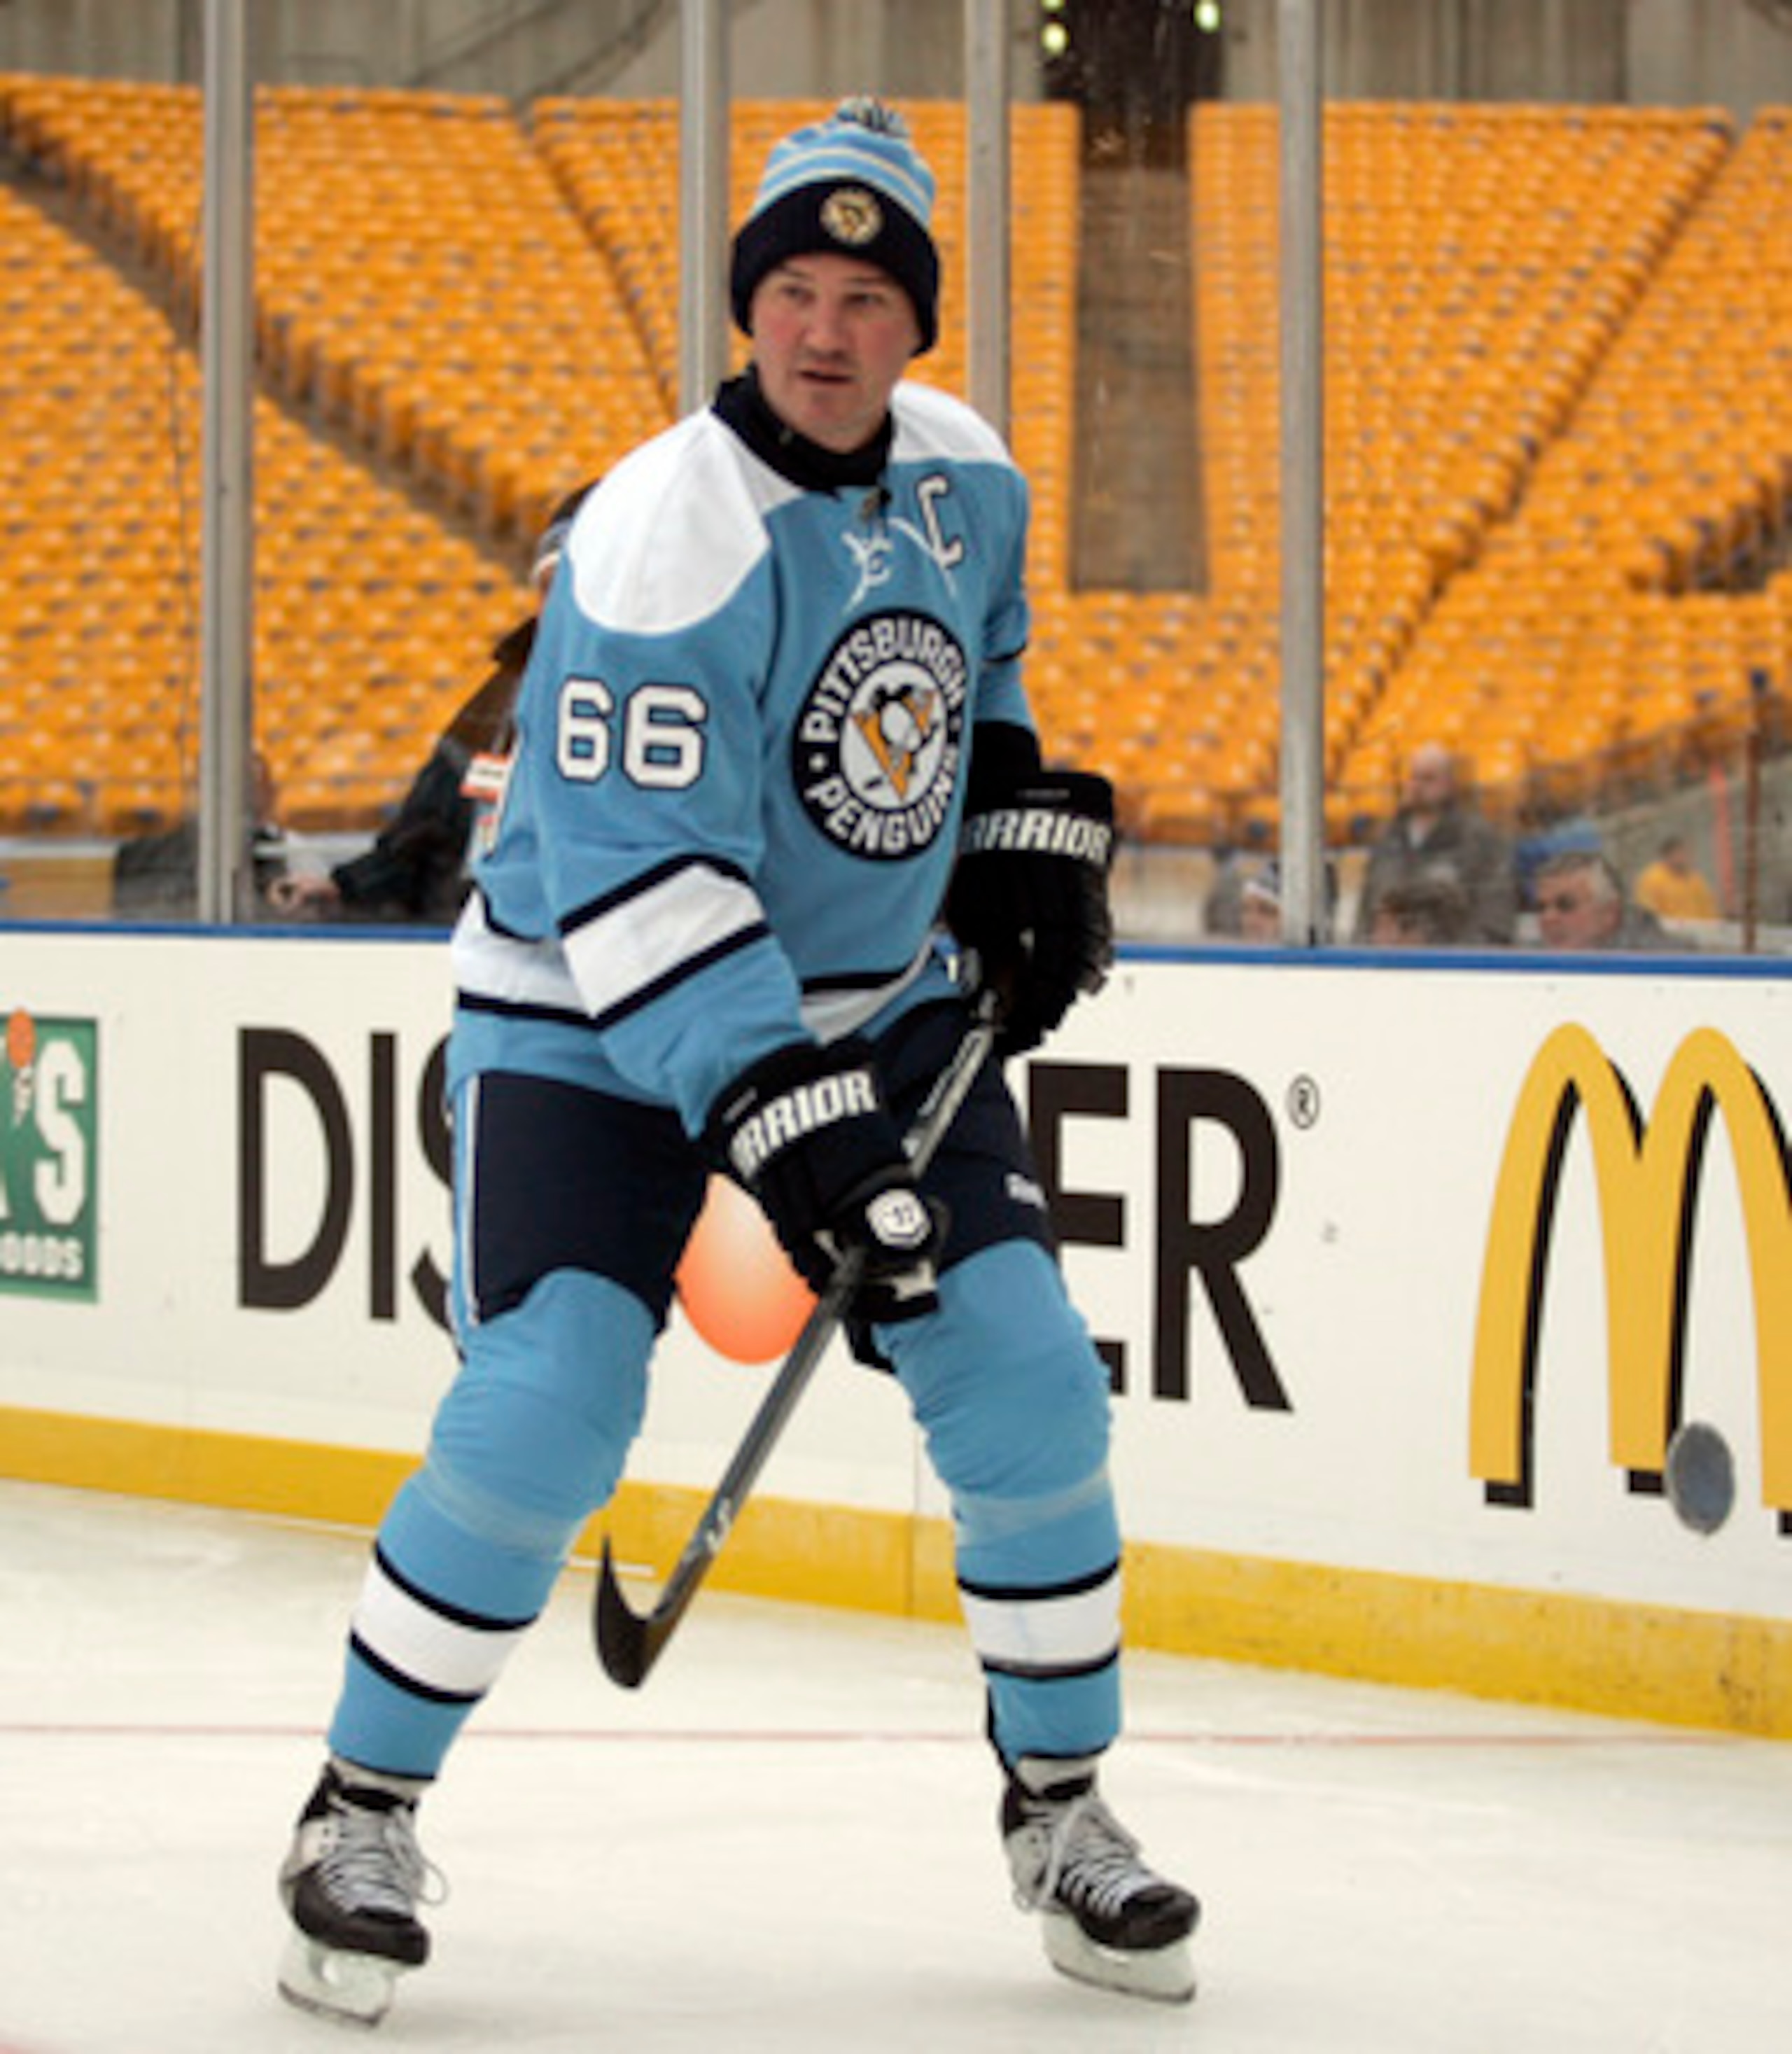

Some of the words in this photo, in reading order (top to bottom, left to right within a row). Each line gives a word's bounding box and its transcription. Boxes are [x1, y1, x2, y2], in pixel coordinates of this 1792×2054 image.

[916, 473, 964, 568] C
[556, 674, 709, 790] 66
[799, 617, 967, 743] PITTSBURGH
